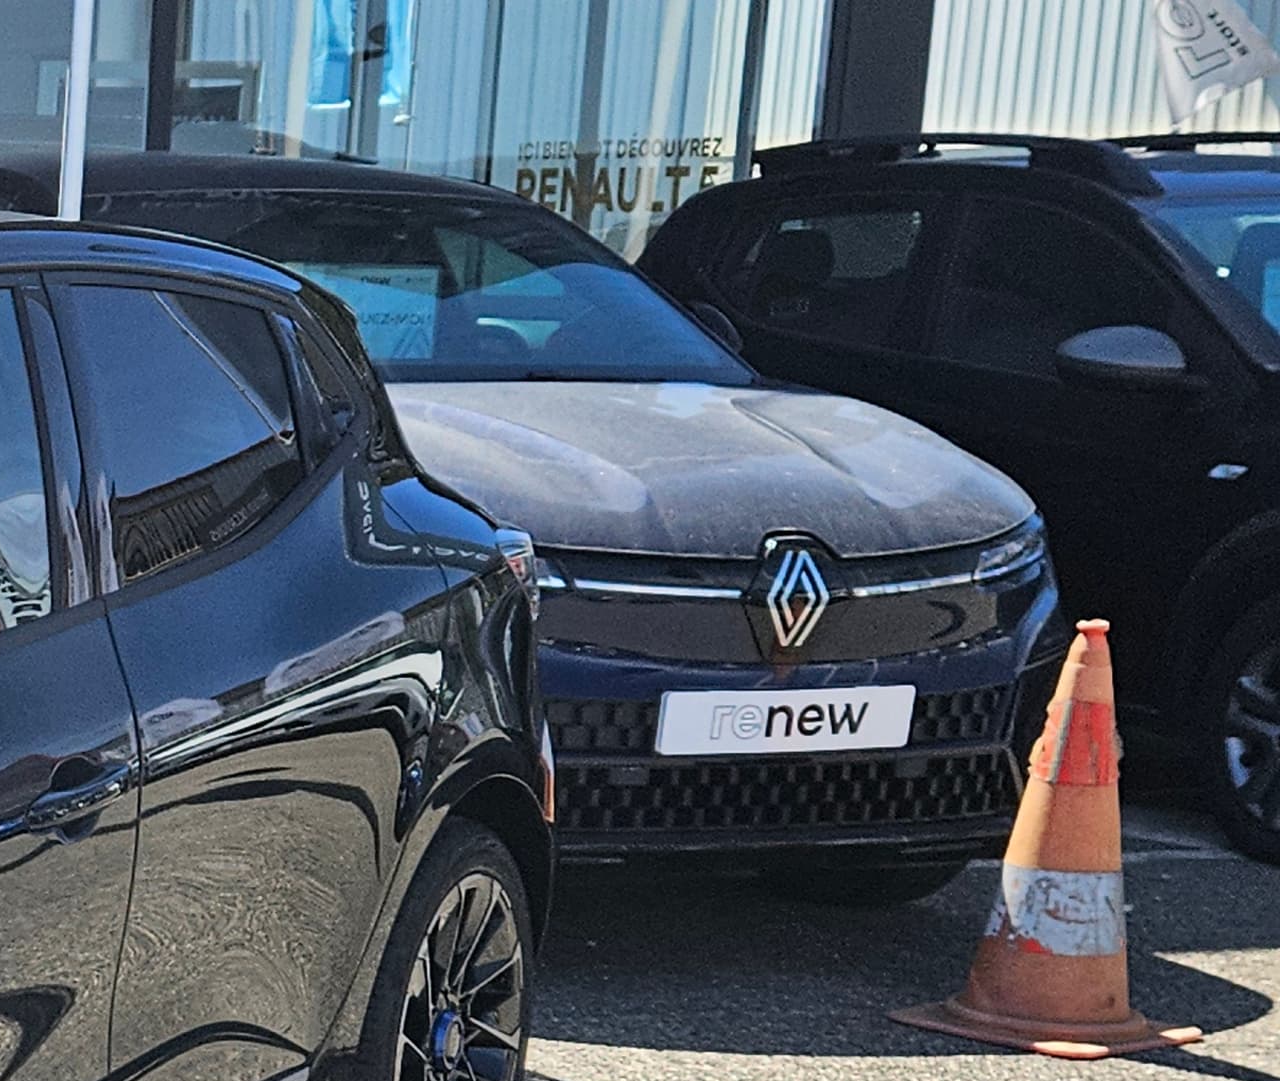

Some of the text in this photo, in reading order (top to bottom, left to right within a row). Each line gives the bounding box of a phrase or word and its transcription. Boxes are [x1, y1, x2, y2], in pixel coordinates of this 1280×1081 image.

[1207, 8, 1249, 56] start
[518, 141, 539, 163] ICI
[709, 701, 869, 740] renew
